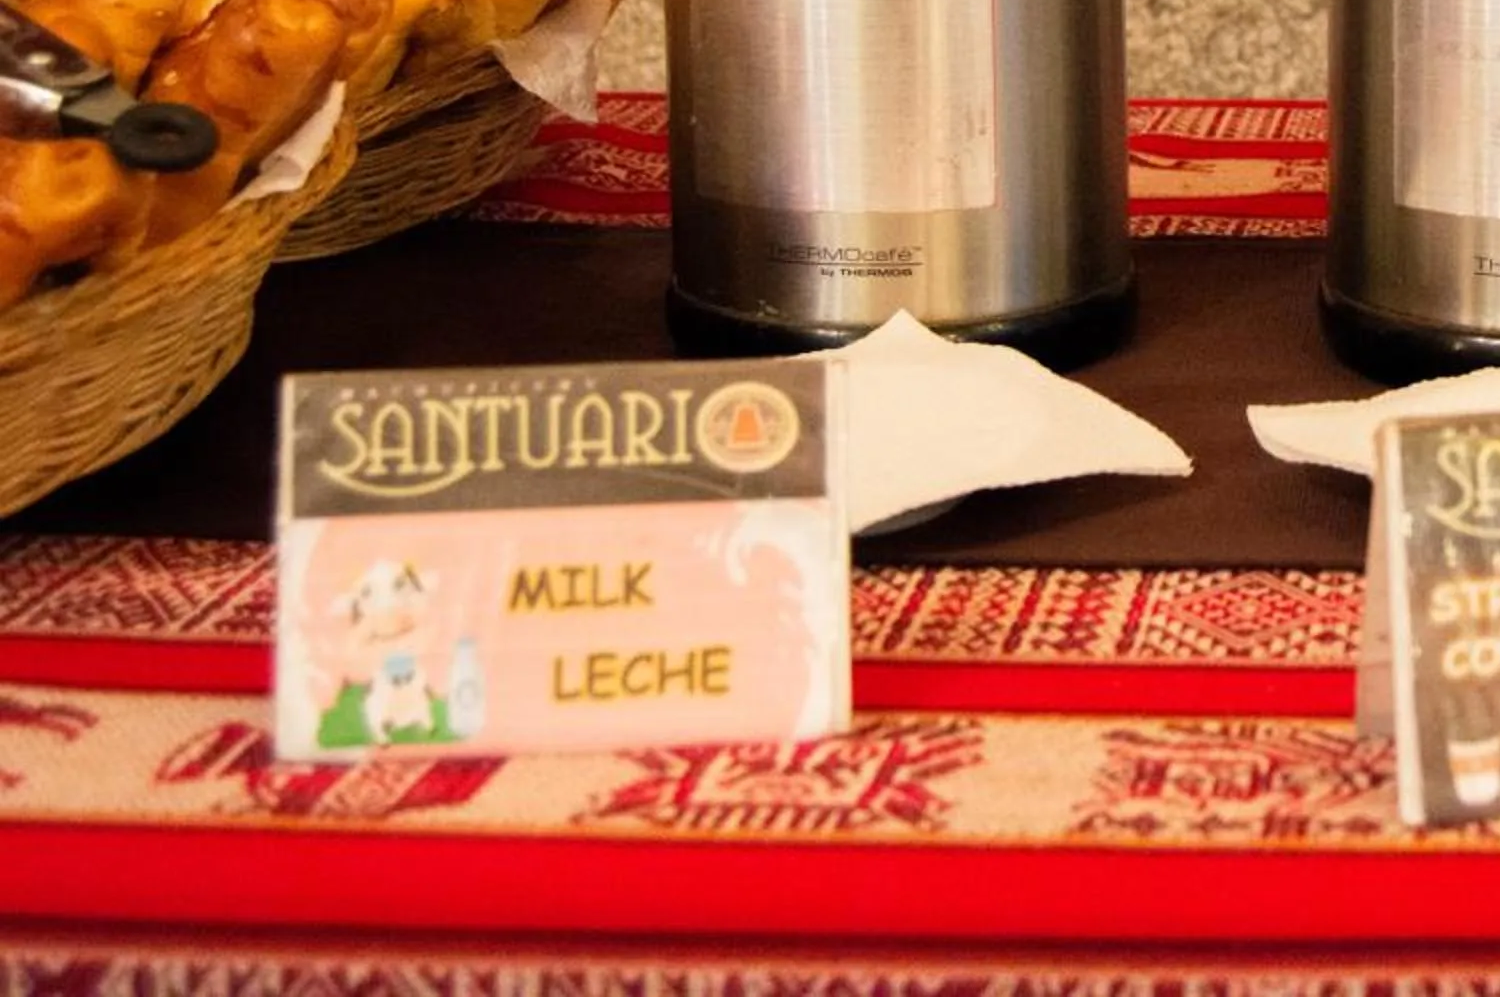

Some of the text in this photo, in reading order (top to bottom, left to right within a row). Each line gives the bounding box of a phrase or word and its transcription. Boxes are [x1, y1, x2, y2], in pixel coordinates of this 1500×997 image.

[840, 268, 913, 278] THERMOS
[507, 562, 654, 613] MILK
[552, 647, 732, 703] LECHE
